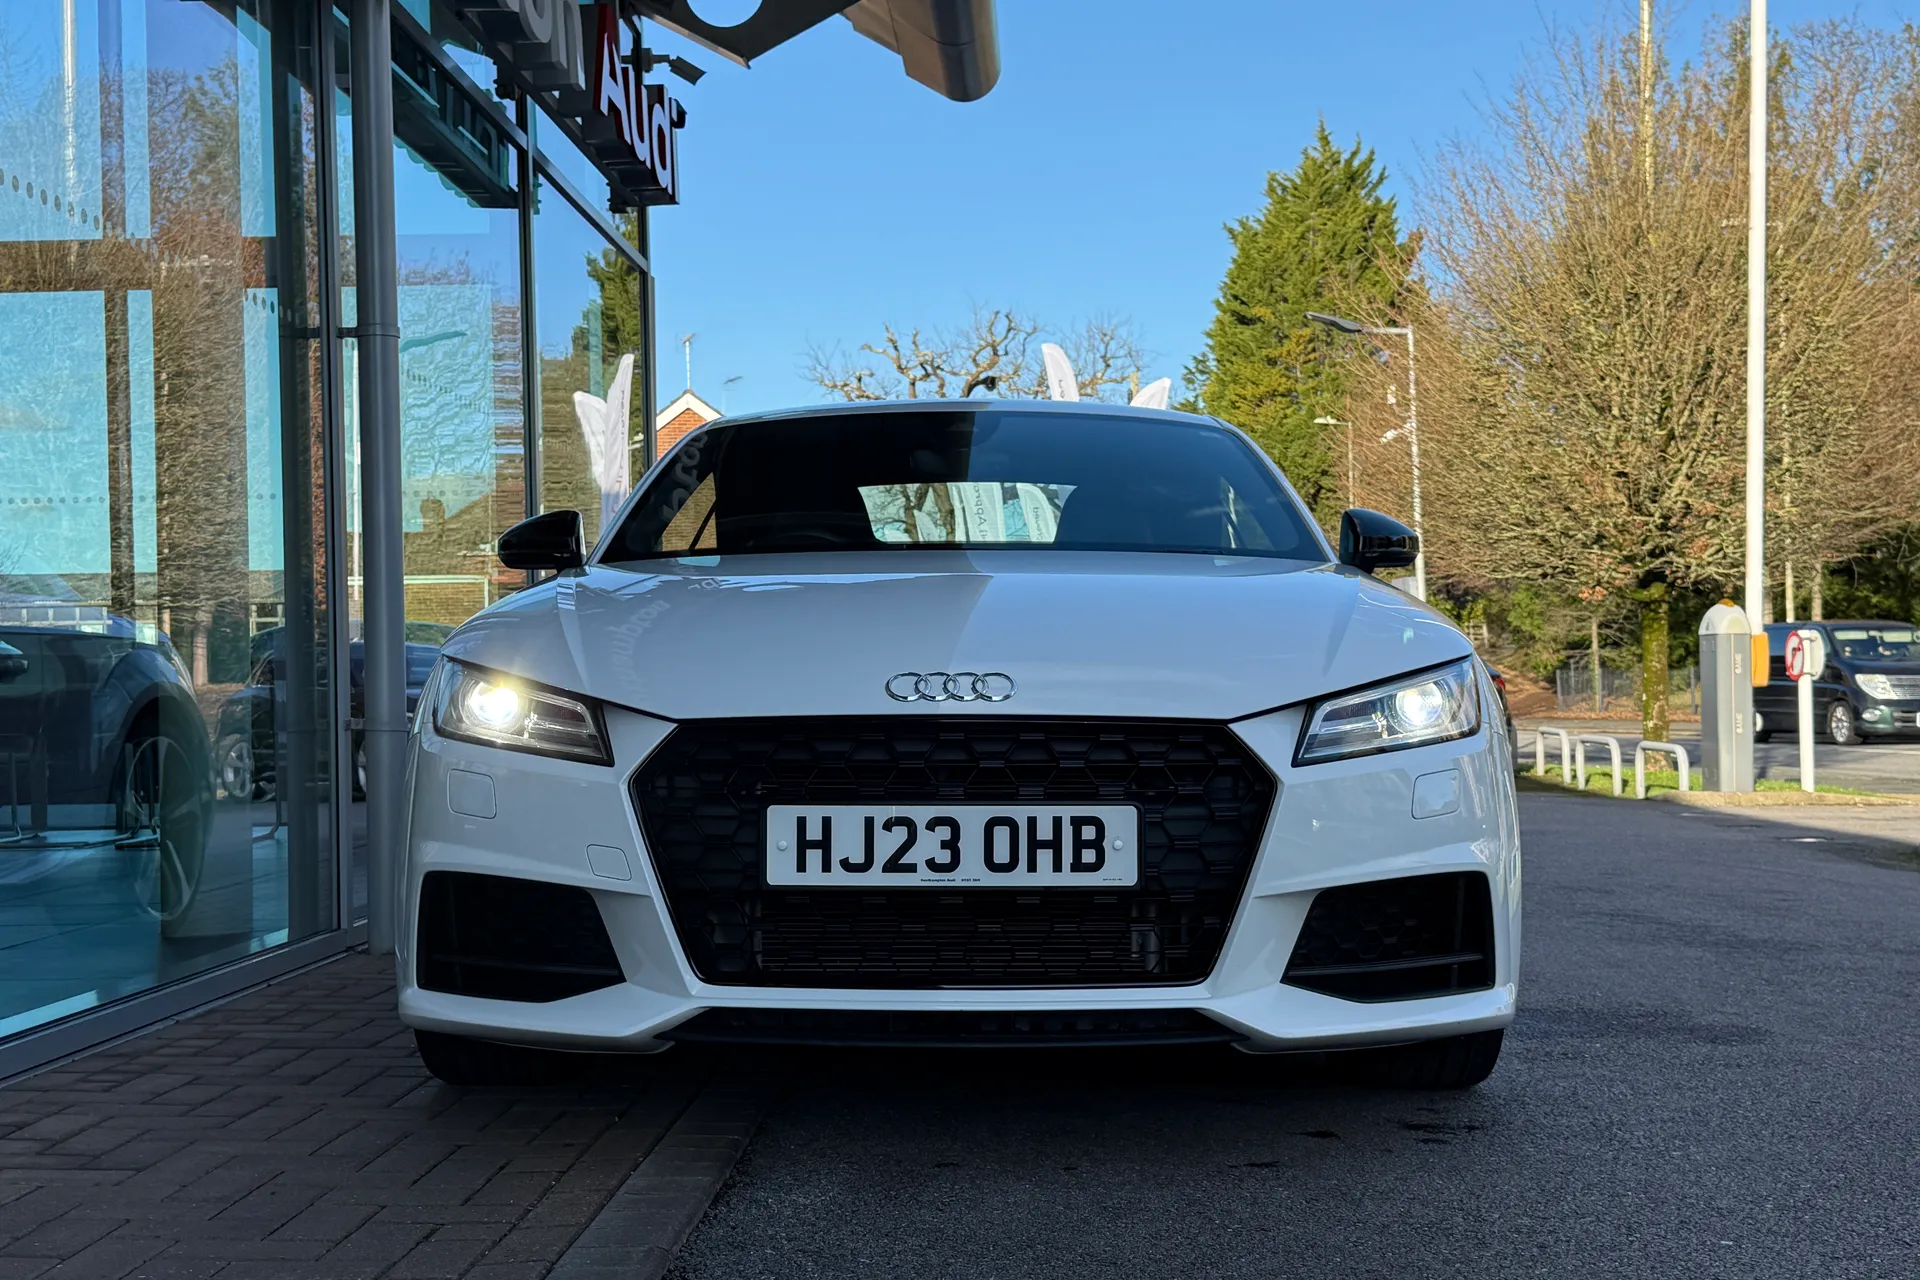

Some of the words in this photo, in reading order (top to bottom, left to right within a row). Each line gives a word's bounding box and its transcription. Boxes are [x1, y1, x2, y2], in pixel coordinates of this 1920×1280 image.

[597, 30, 680, 205] Audi
[795, 815, 961, 874] HJ23
[983, 815, 1106, 874] OHB
